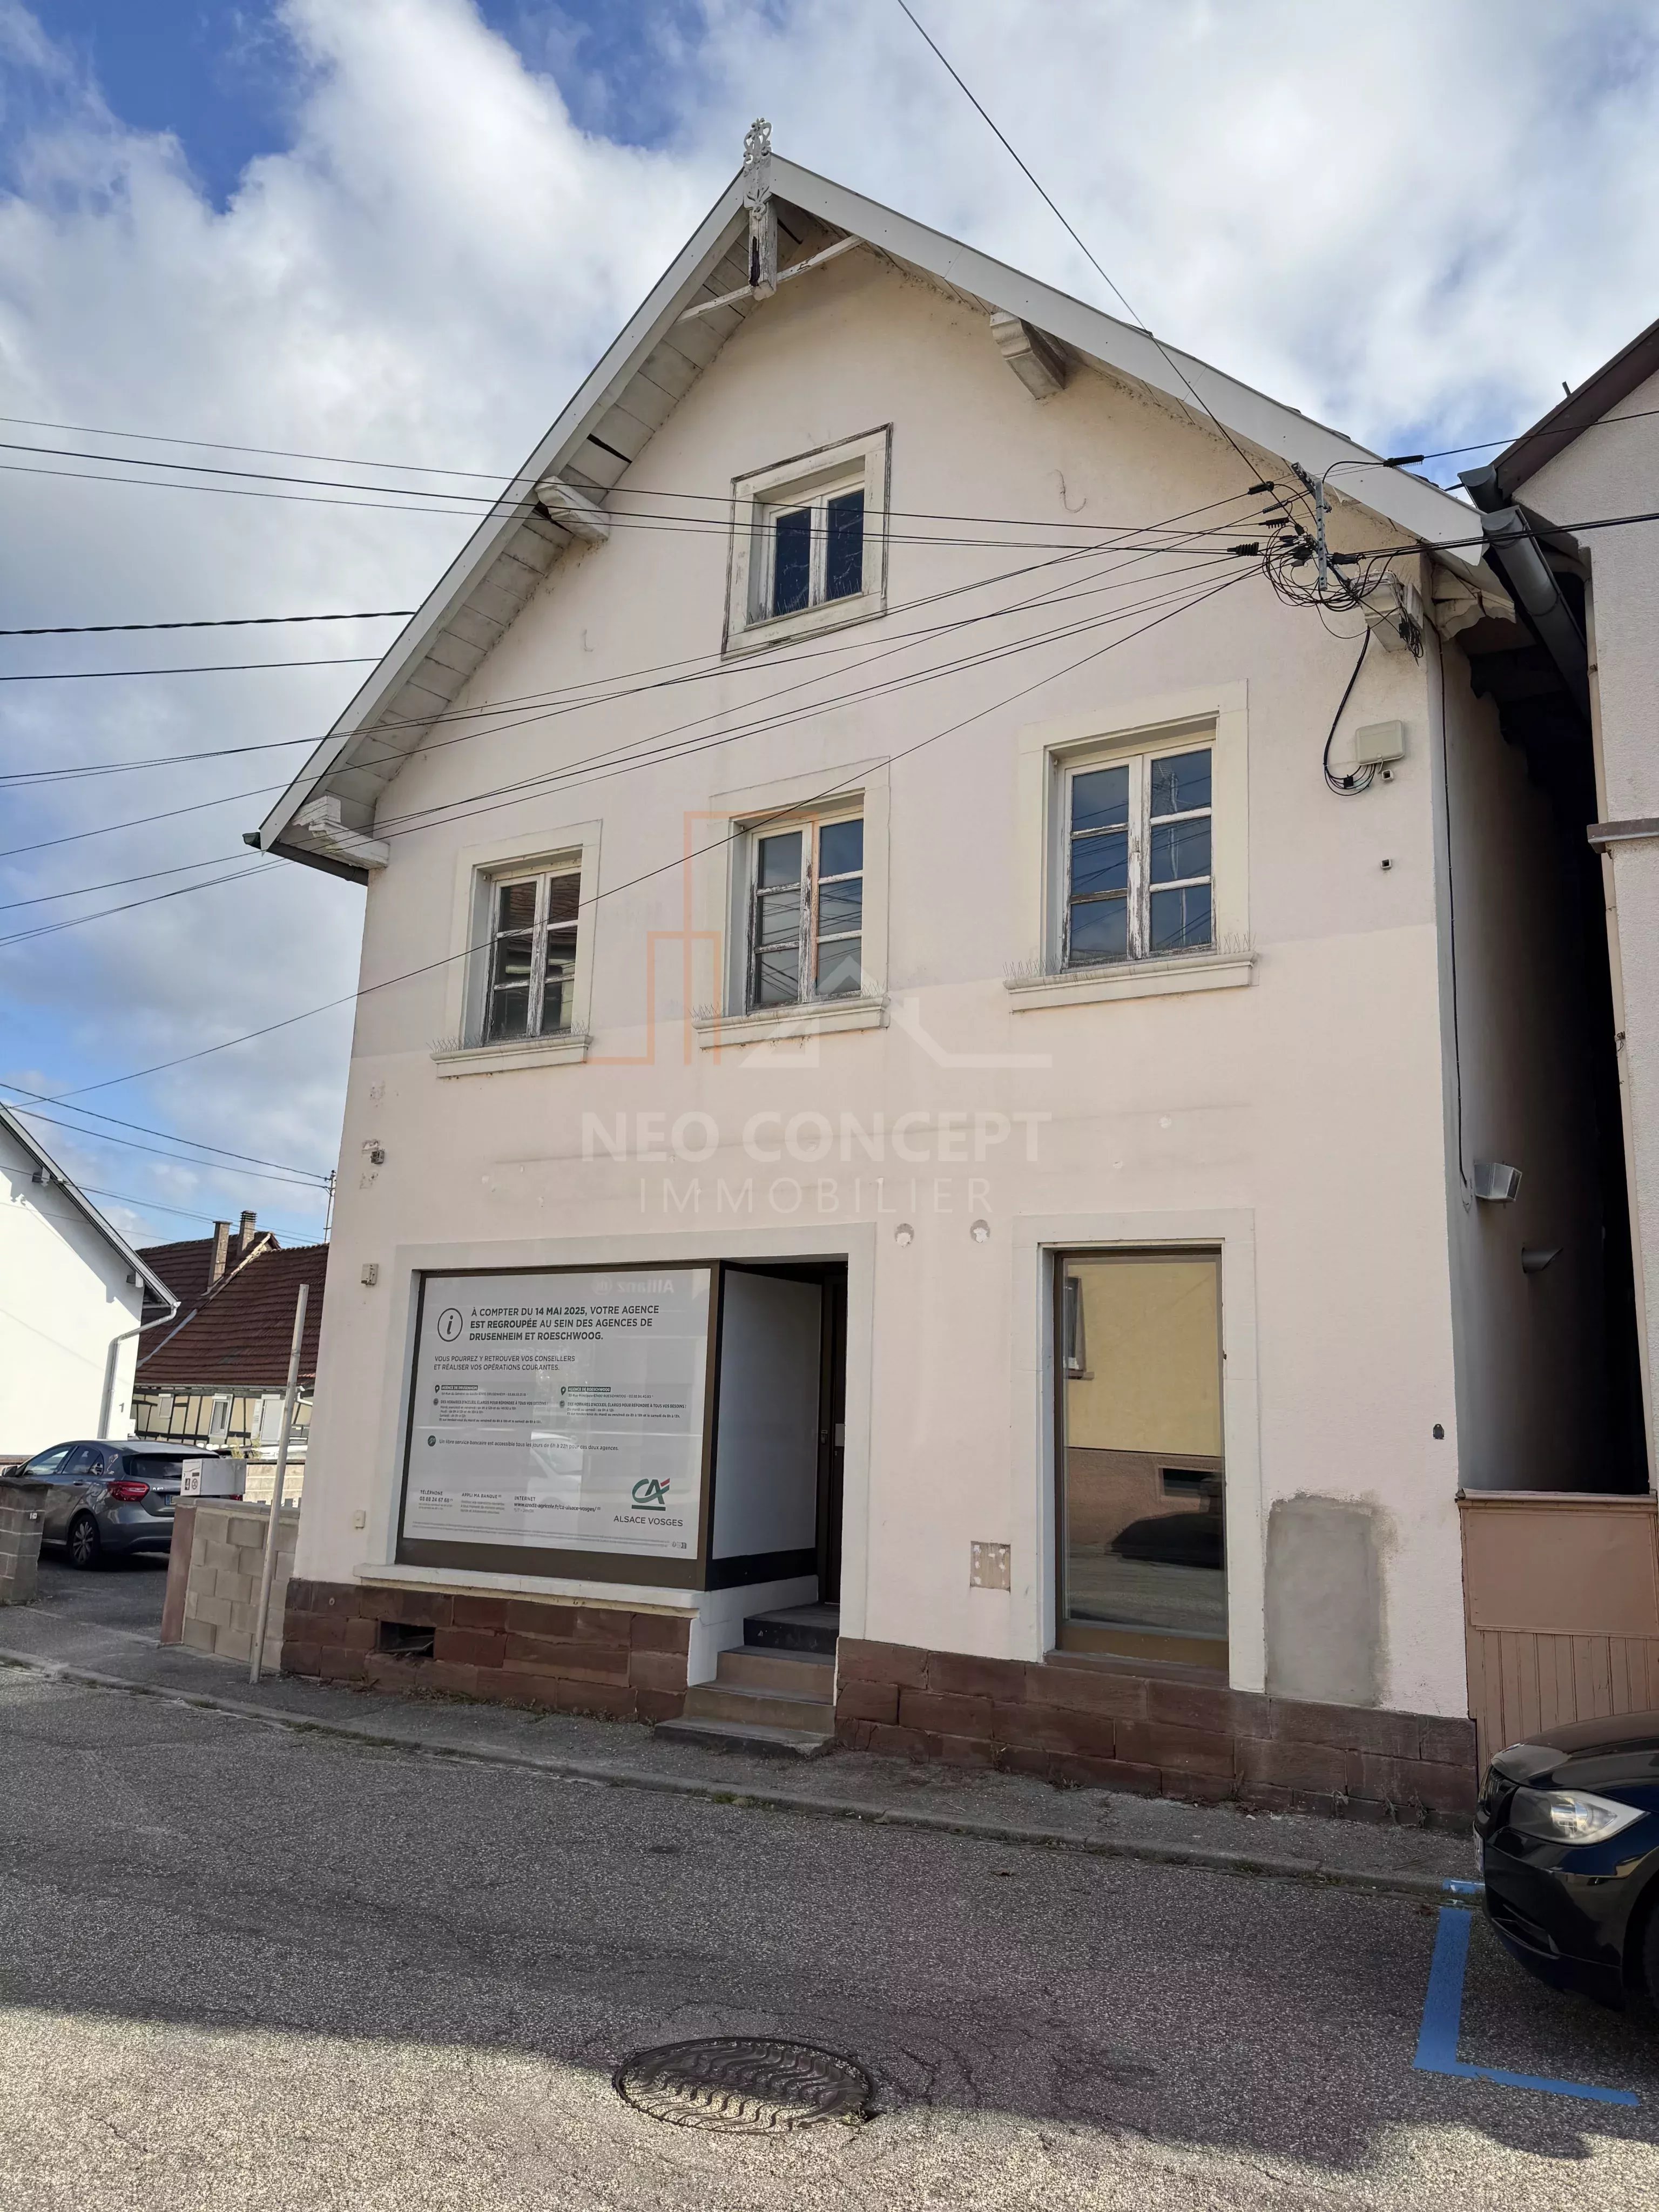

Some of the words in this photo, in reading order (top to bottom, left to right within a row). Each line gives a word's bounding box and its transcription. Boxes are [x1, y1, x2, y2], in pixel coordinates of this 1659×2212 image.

[471, 1307, 477, 1316] À
[480, 1308, 518, 1316] COMPTER
[564, 1307, 587, 1316] 2025,
[590, 1306, 619, 1314] VOTRE
[622, 1305, 659, 1314] AGENCE
[487, 1318, 537, 1328] REGROUPÉE
[554, 1319, 573, 1327] SEIN
[576, 1319, 593, 1327] DES
[595, 1318, 637, 1327] AGENCES
[640, 1318, 652, 1326] DE
[469, 1332, 523, 1340] DRUSENHEIM
[525, 1332, 535, 1340] ET
[537, 1332, 603, 1340] ROESCHWOOG.
[613, 1515, 646, 1524] ALSACE
[648, 1518, 683, 1527] VOSGES
